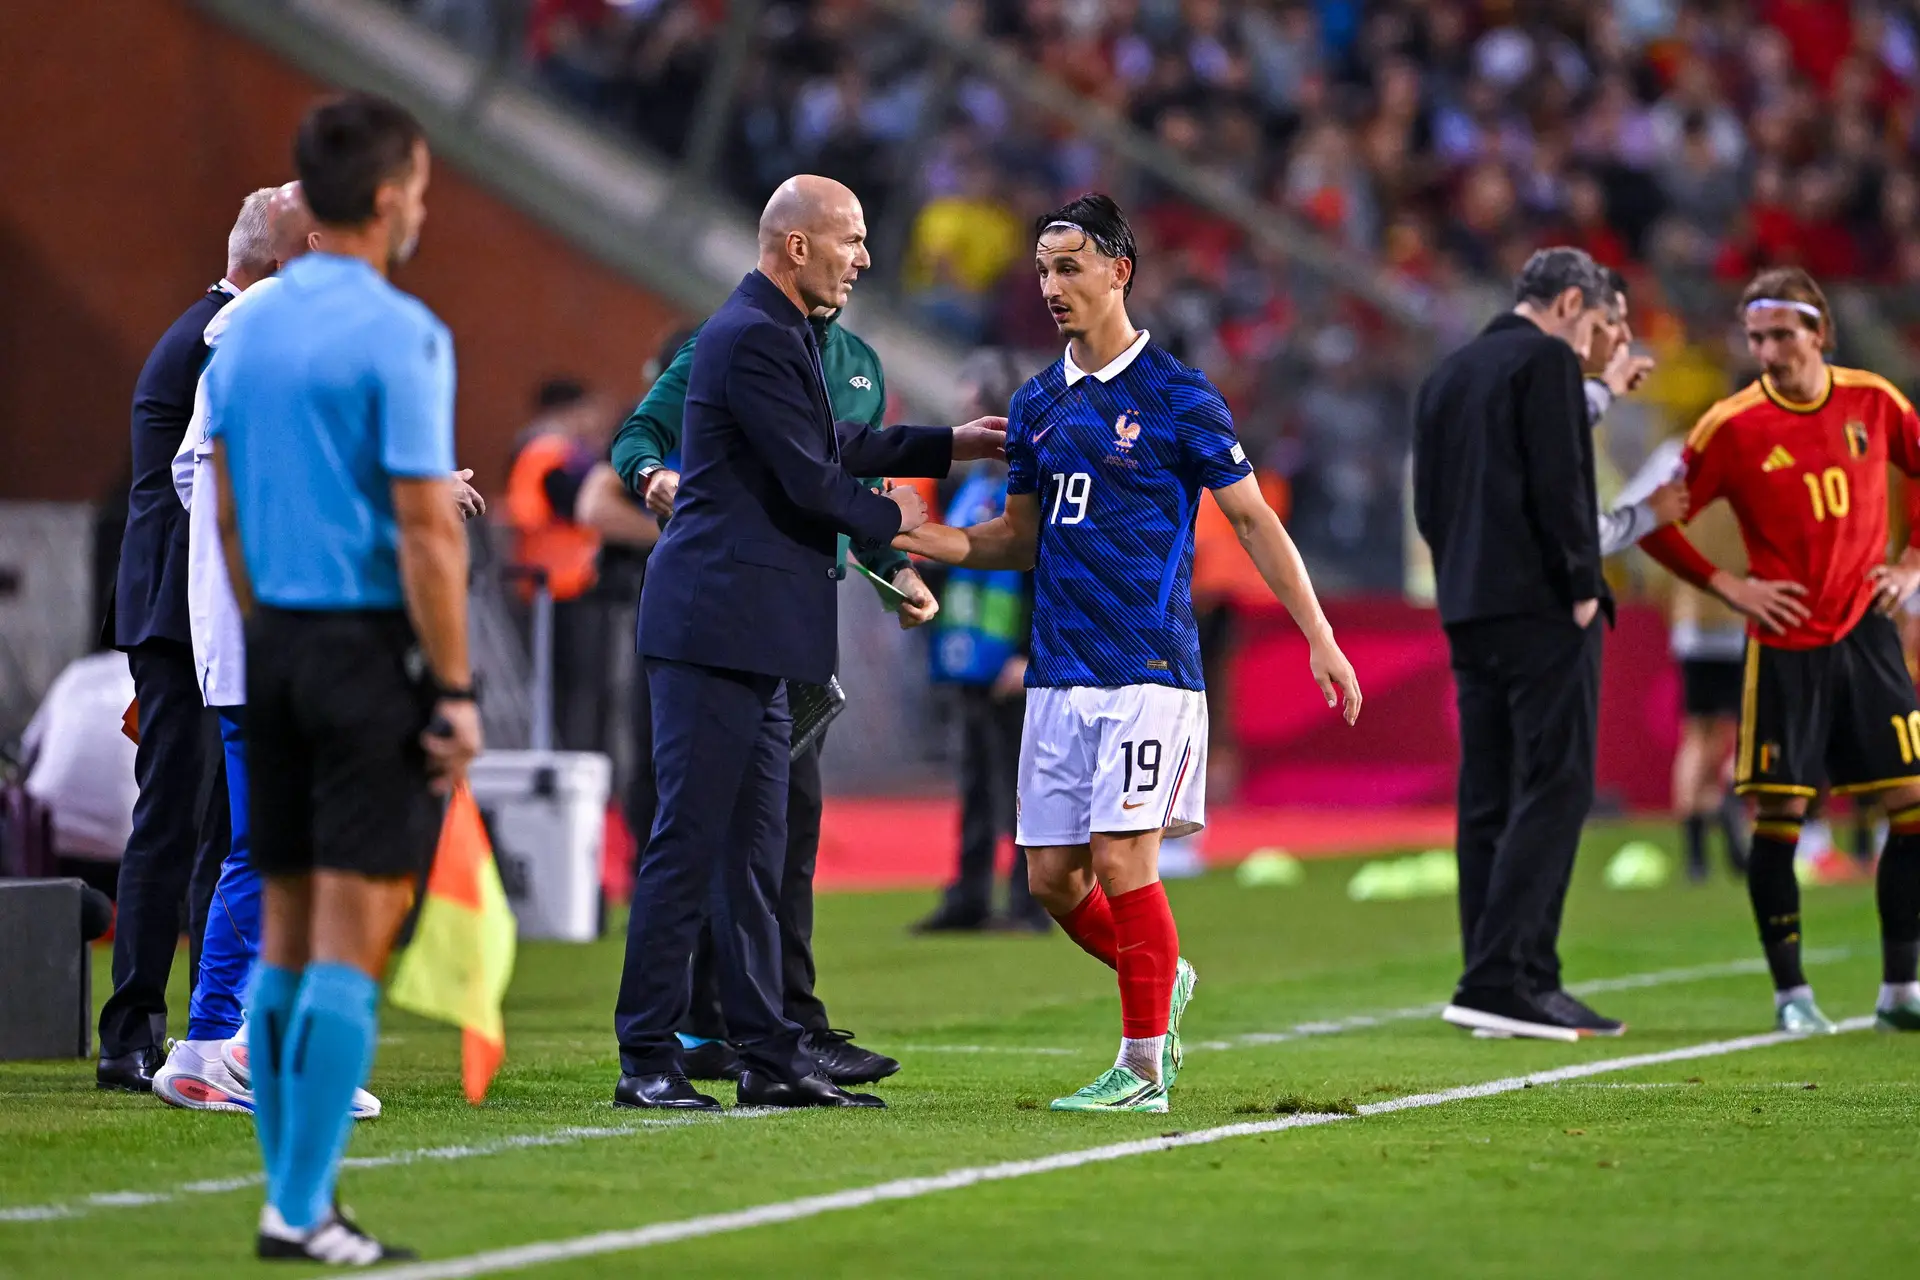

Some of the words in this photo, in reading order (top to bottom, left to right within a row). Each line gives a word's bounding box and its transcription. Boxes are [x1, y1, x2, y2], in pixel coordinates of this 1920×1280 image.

[849, 376, 872, 391] UEFA
[1050, 472, 1092, 525] 19
[1803, 466, 1850, 522] 10
[1121, 739, 1162, 793] 19
